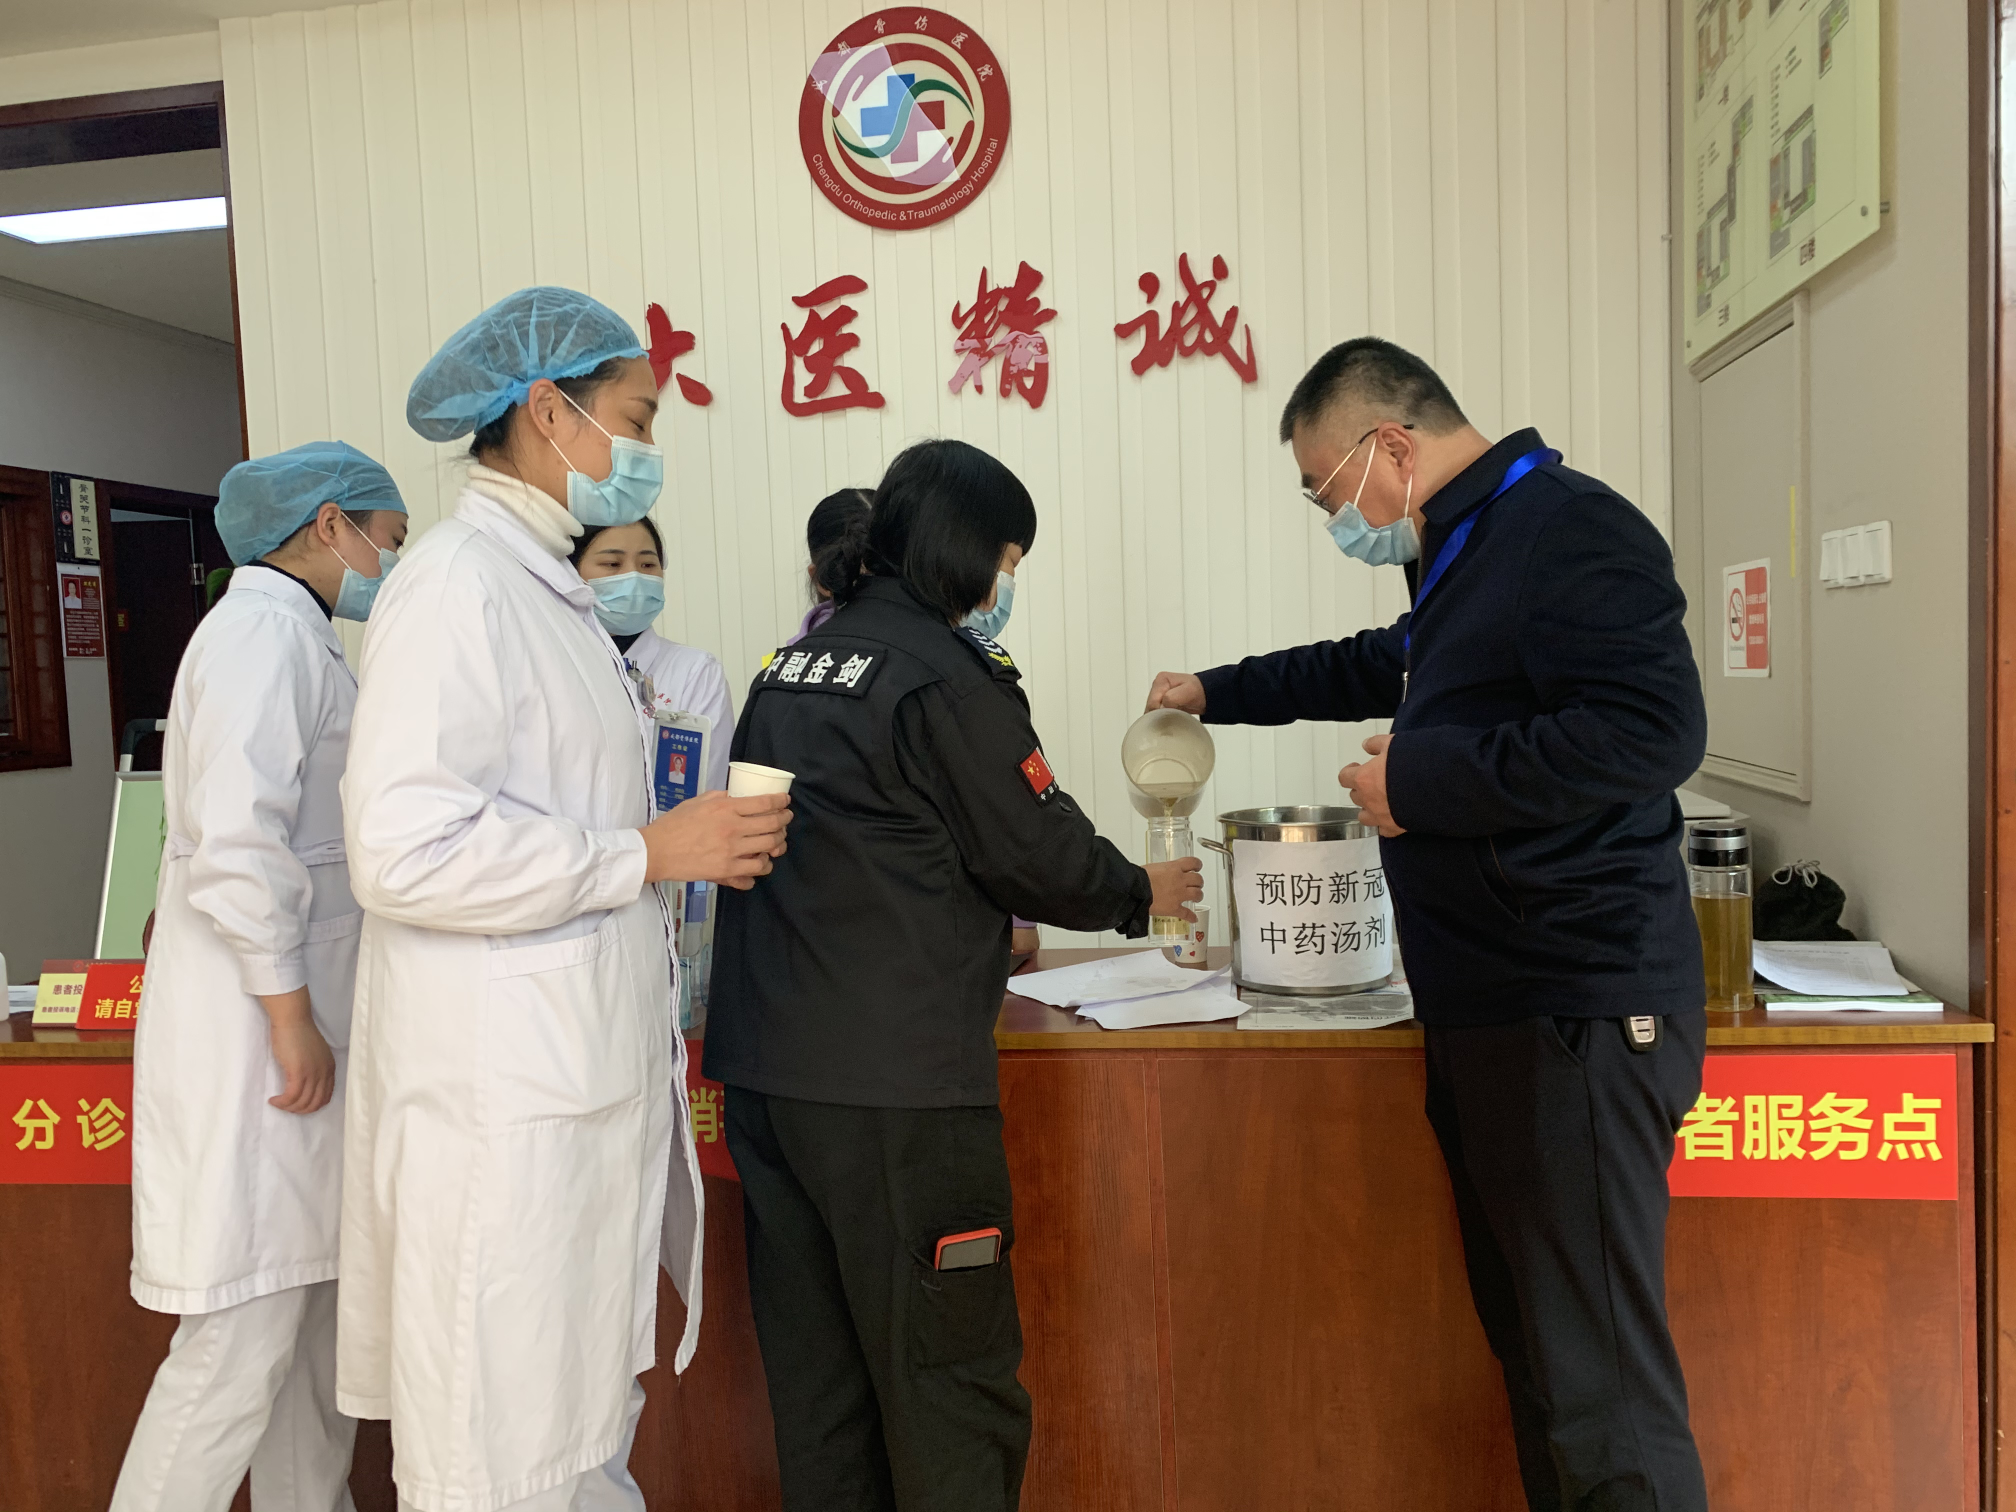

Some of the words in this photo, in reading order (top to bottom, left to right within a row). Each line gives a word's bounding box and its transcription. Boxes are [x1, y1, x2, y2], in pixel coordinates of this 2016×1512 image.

[812, 153, 842, 197] Chengdu
[842, 193, 897, 221] Orthopedic
[970, 138, 998, 183] Hospital
[763, 651, 873, 688] 中融金剑
[1255, 865, 1385, 907] 预防新冠
[1260, 915, 1386, 956] 中药汤剂
[12, 1098, 126, 1151] 分诊
